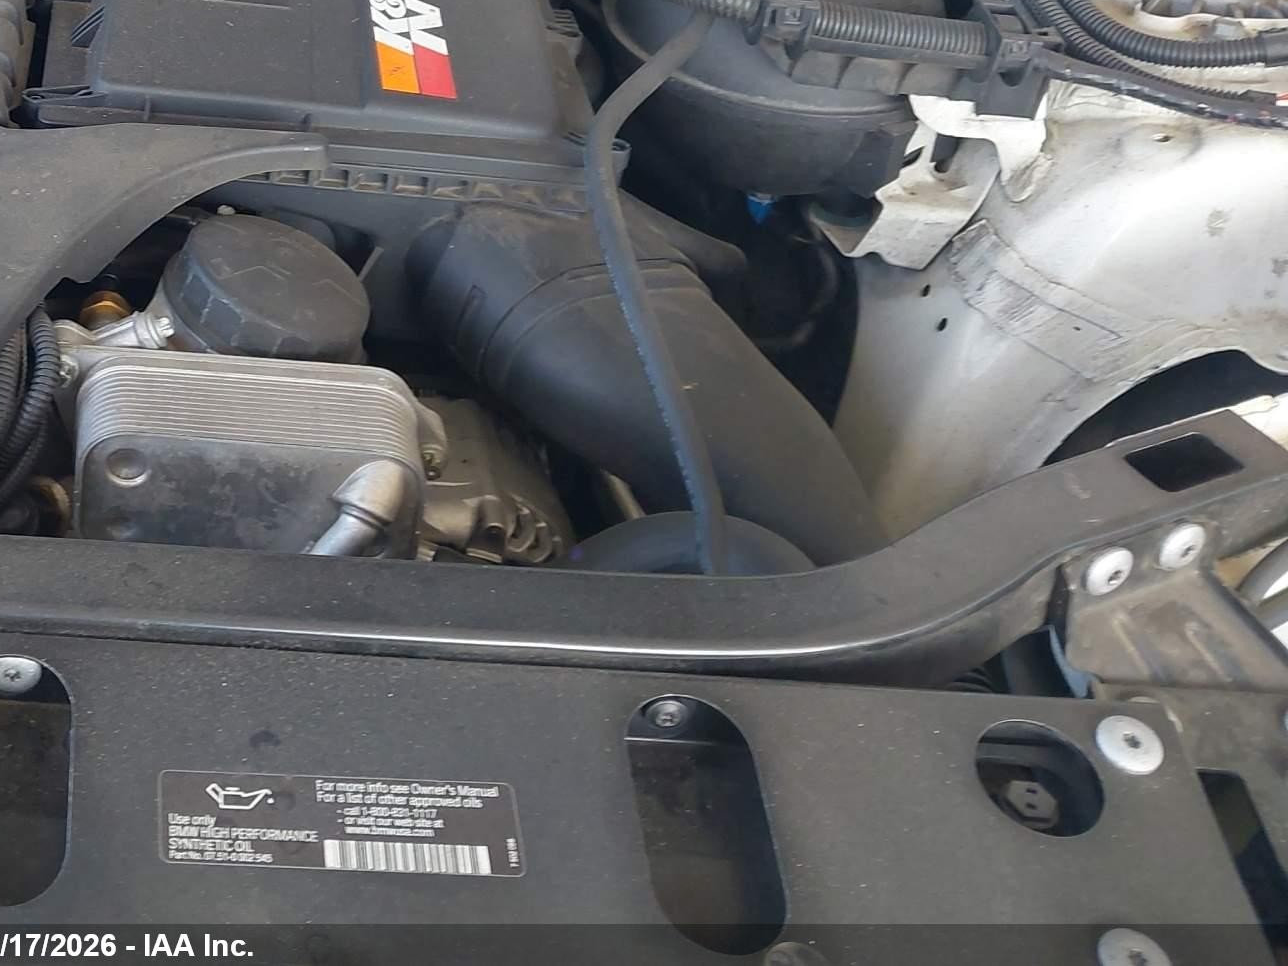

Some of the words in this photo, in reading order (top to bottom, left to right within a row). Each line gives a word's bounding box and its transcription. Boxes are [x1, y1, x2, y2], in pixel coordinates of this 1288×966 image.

[315, 780, 335, 791] For
[336, 782, 366, 792] more
[366, 781, 389, 793] info
[389, 785, 410, 794] see
[410, 783, 456, 796] Owner's
[457, 785, 499, 797] Manual
[316, 791, 336, 803] For
[336, 794, 345, 803] a
[345, 792, 363, 804] list
[364, 792, 377, 804] of
[377, 793, 408, 805] other
[409, 796, 462, 808] approved
[462, 797, 484, 808] oils
[168, 813, 190, 825] Use
[191, 814, 217, 827] only
[168, 825, 200, 837] BMW
[200, 826, 230, 839] HIGH
[231, 827, 320, 843] PERFORMANCE
[168, 837, 234, 851] SYNTHETIC
[234, 840, 255, 853] OIL
